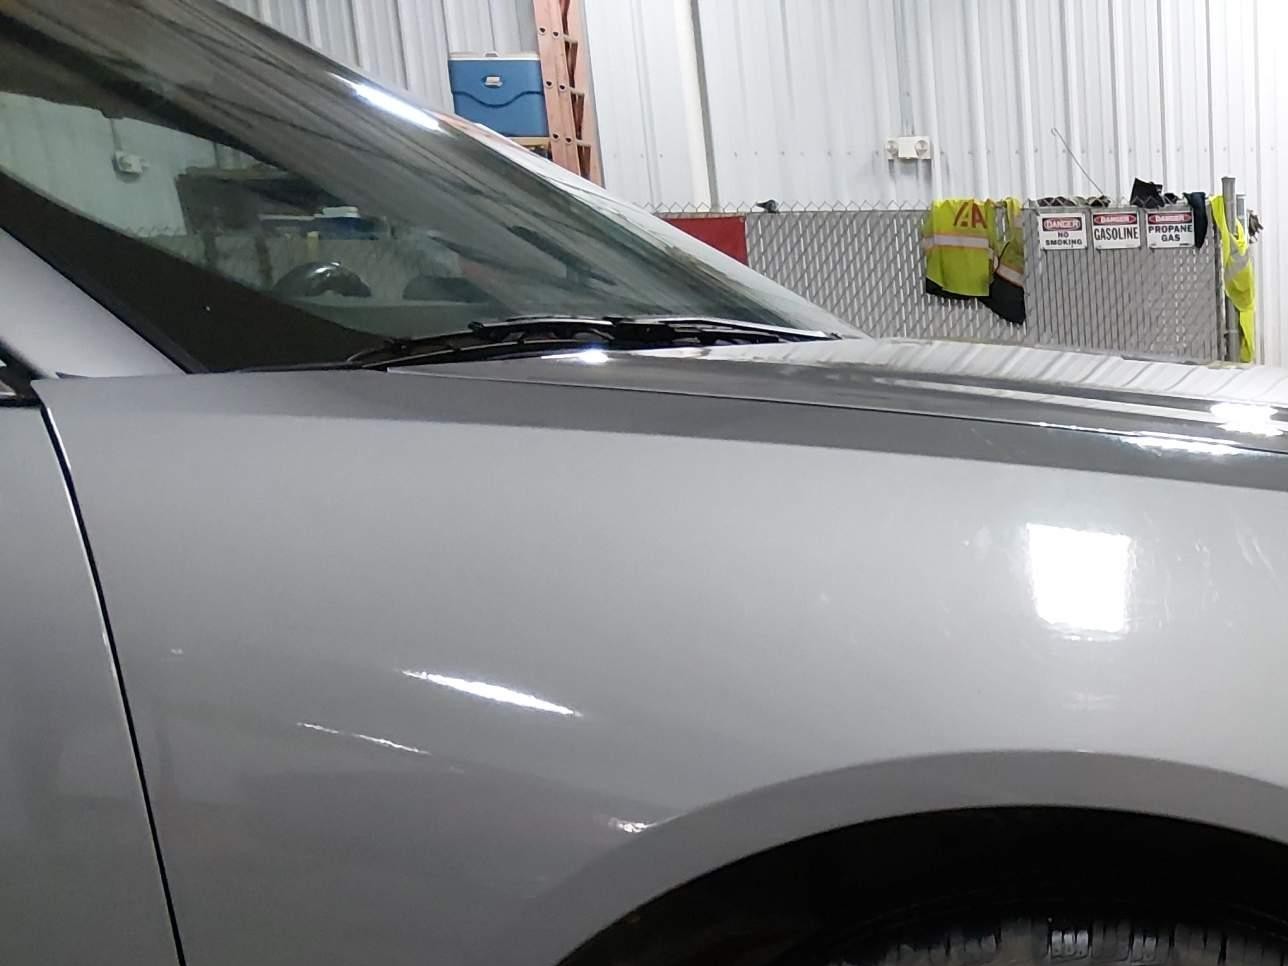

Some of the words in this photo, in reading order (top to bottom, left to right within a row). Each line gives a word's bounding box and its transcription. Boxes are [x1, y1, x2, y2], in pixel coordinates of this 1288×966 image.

[1045, 219, 1080, 229] DANGER
[1148, 224, 1193, 234] PROPANE
[1093, 227, 1139, 241] GASOLINE
[1161, 234, 1181, 242] GAS
[1045, 238, 1083, 246] SMOKING
